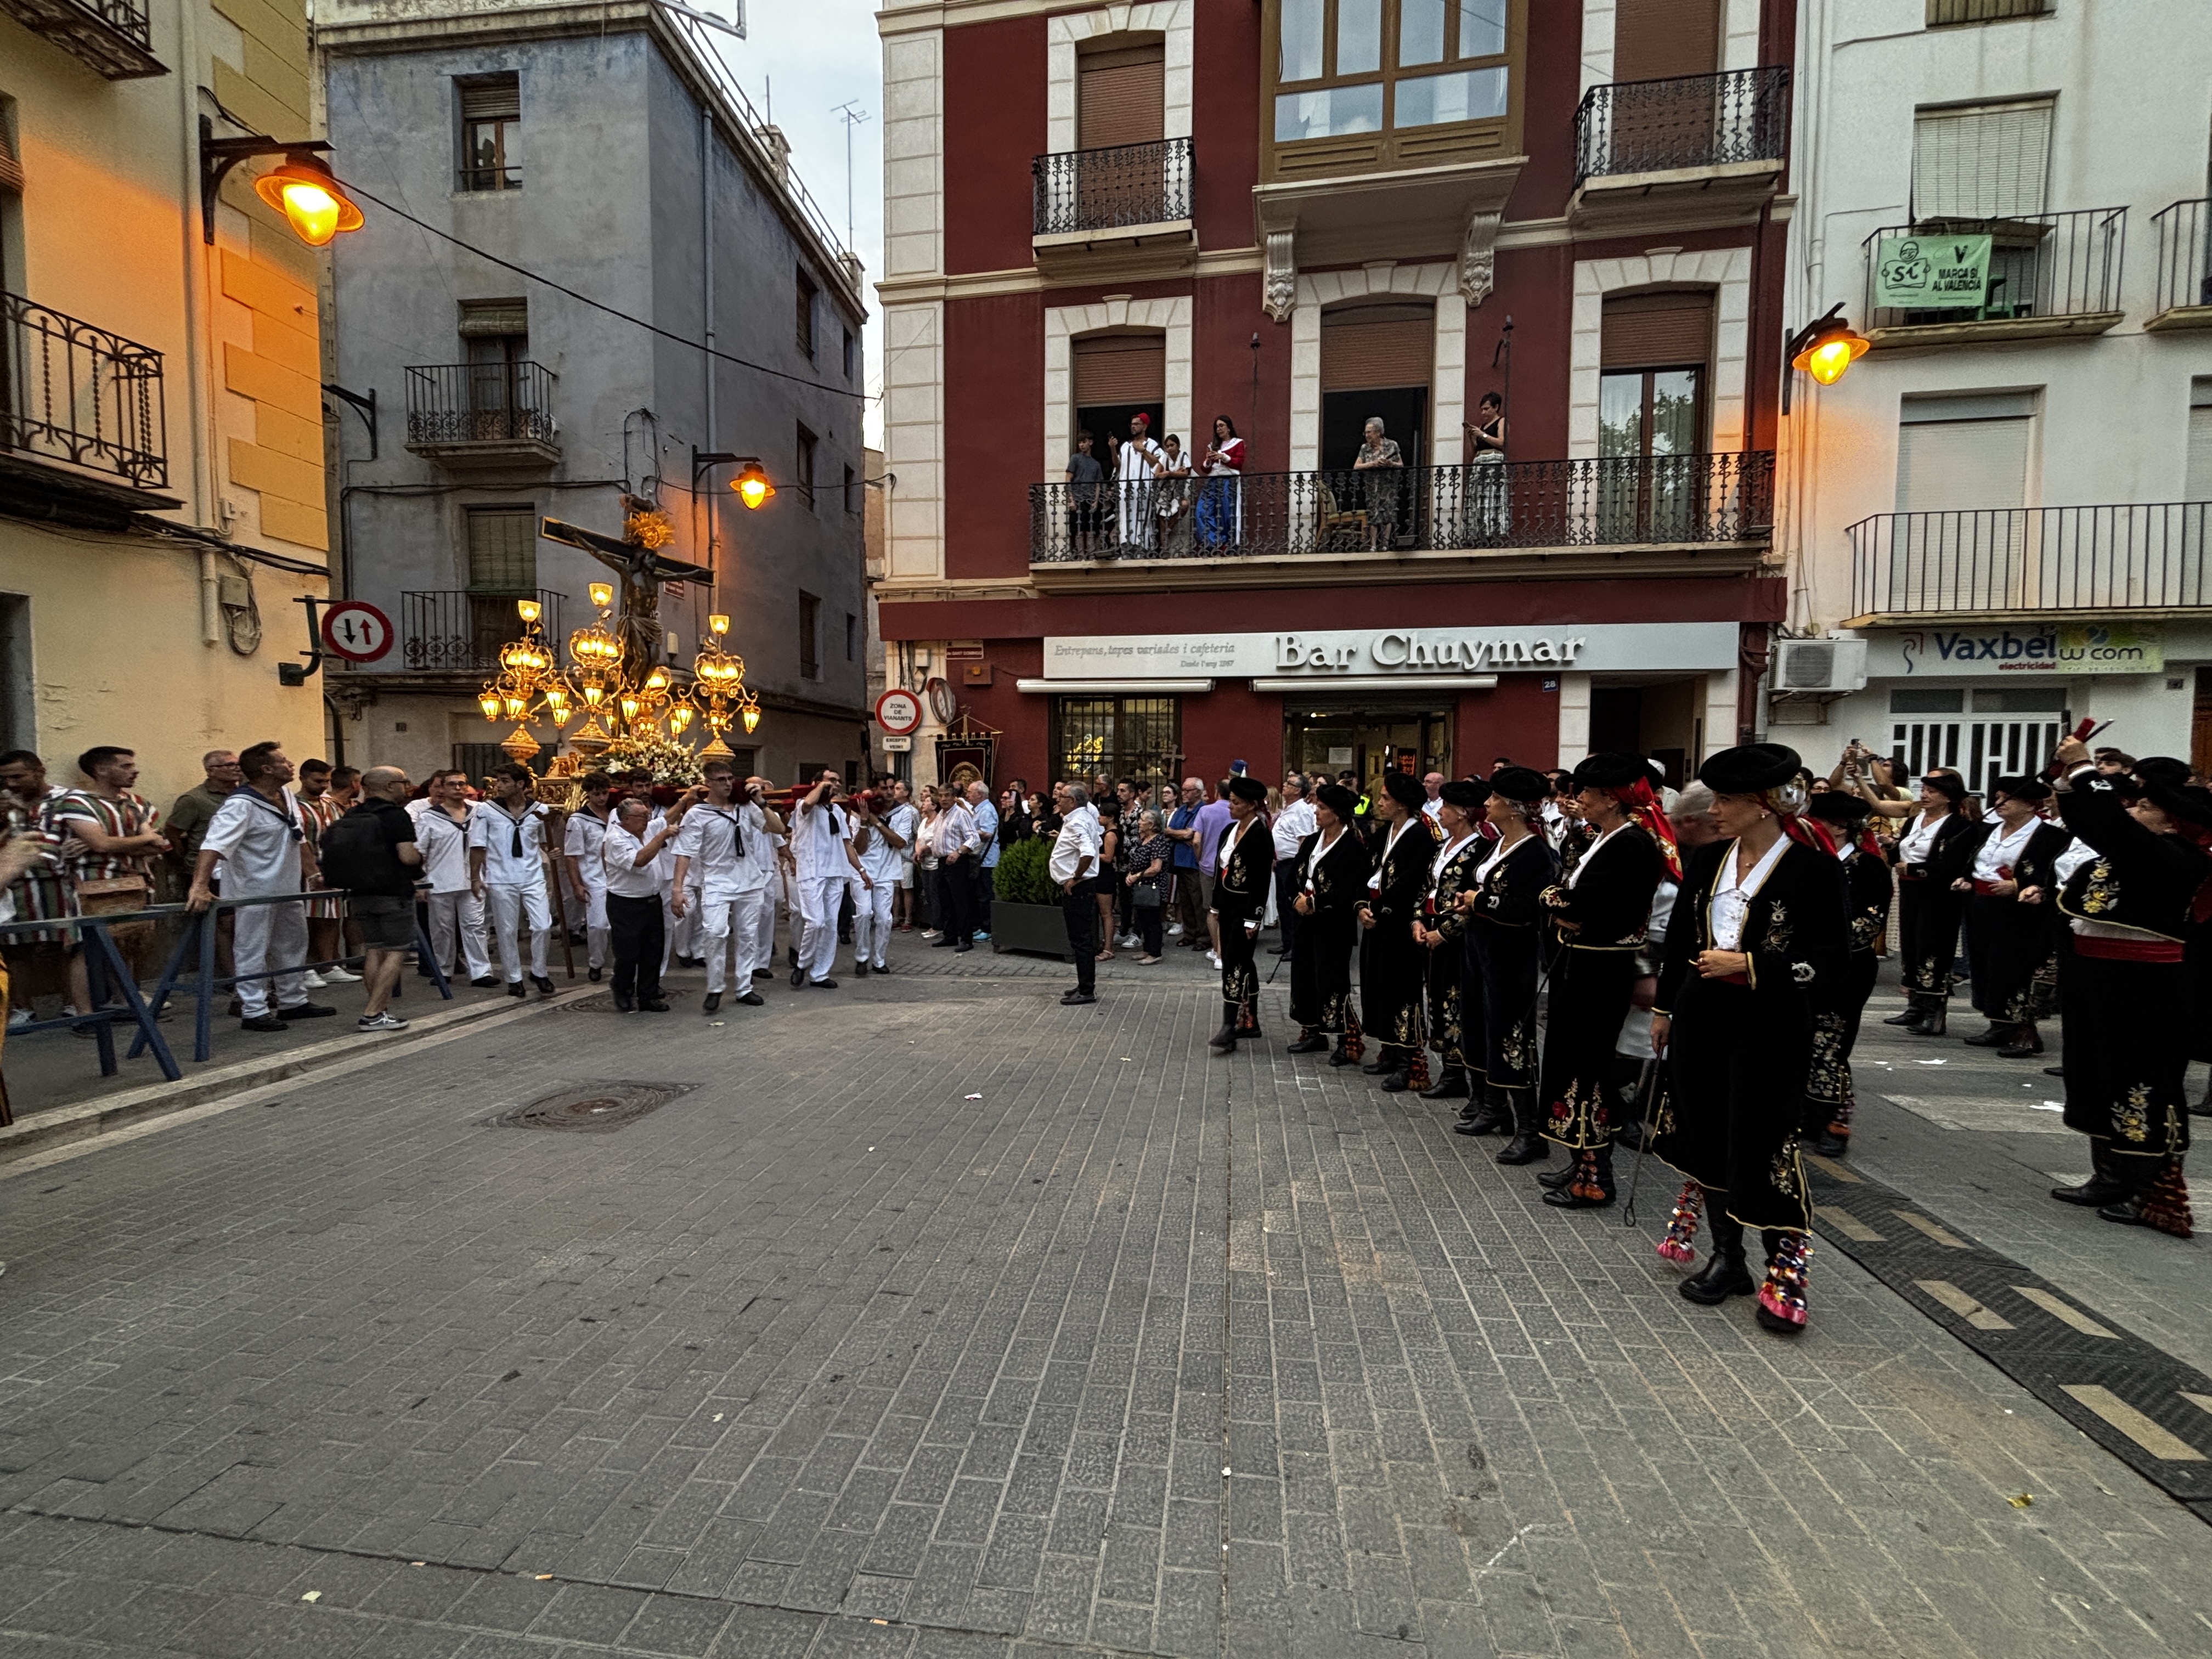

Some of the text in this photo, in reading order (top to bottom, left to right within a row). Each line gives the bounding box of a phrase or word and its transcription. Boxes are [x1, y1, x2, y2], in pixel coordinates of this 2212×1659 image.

[1938, 268, 1969, 279] MARCA
[1932, 280, 1943, 291] AL
[1137, 644, 1180, 655] variades
[1183, 643, 1188, 654] i
[1190, 642, 1235, 657] cafeteria
[1276, 632, 1587, 670] Bar Chuymar
[1934, 631, 2057, 661] Vaxbel
[1999, 662, 2056, 670] electricidad
[1544, 680, 1556, 689] 28
